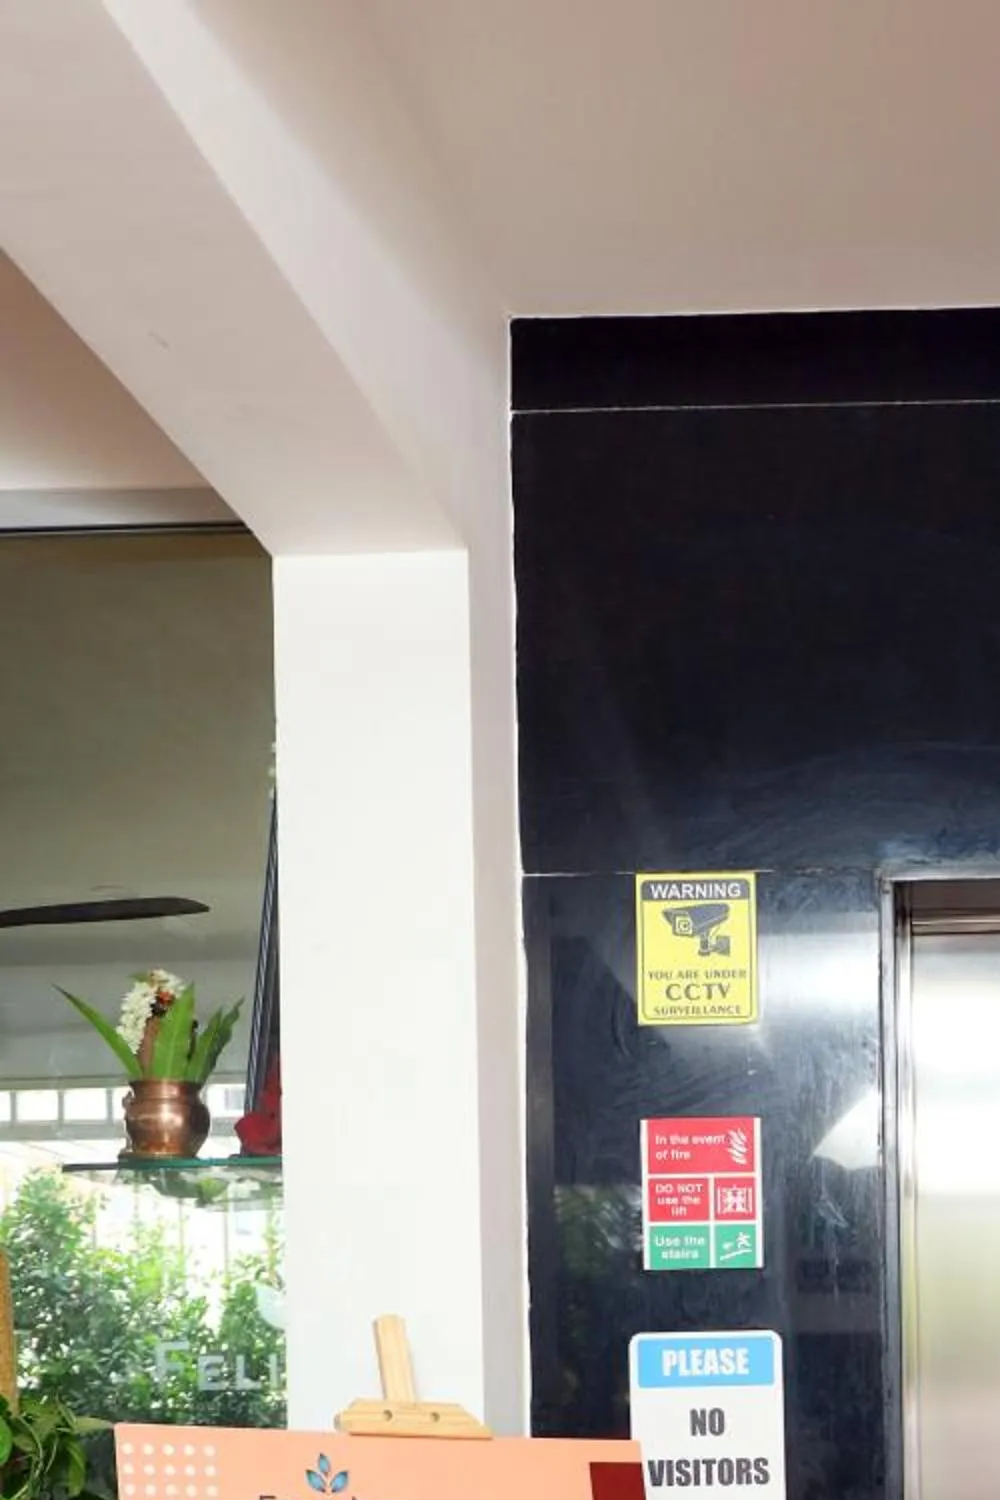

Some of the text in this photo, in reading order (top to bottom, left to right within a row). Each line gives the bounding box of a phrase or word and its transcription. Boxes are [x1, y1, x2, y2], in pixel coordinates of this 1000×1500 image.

[650, 883, 741, 899] WARNING
[648, 969, 747, 980] YOU ARE UNDER
[666, 983, 731, 1001] CCTV
[653, 1004, 741, 1015] SURVEILLANCE
[655, 1134, 726, 1145] In the event
[655, 1150, 691, 1160] of fire
[655, 1183, 703, 1193] DO NOT
[657, 1196, 700, 1205] use the
[671, 1206, 687, 1216] lift
[655, 1235, 705, 1246] Use the
[661, 1249, 700, 1260] stairs
[155, 1340, 278, 1391] FELI
[662, 1348, 750, 1377] PLEASE
[690, 1408, 725, 1437] NO
[648, 1458, 770, 1487] VISITORS
